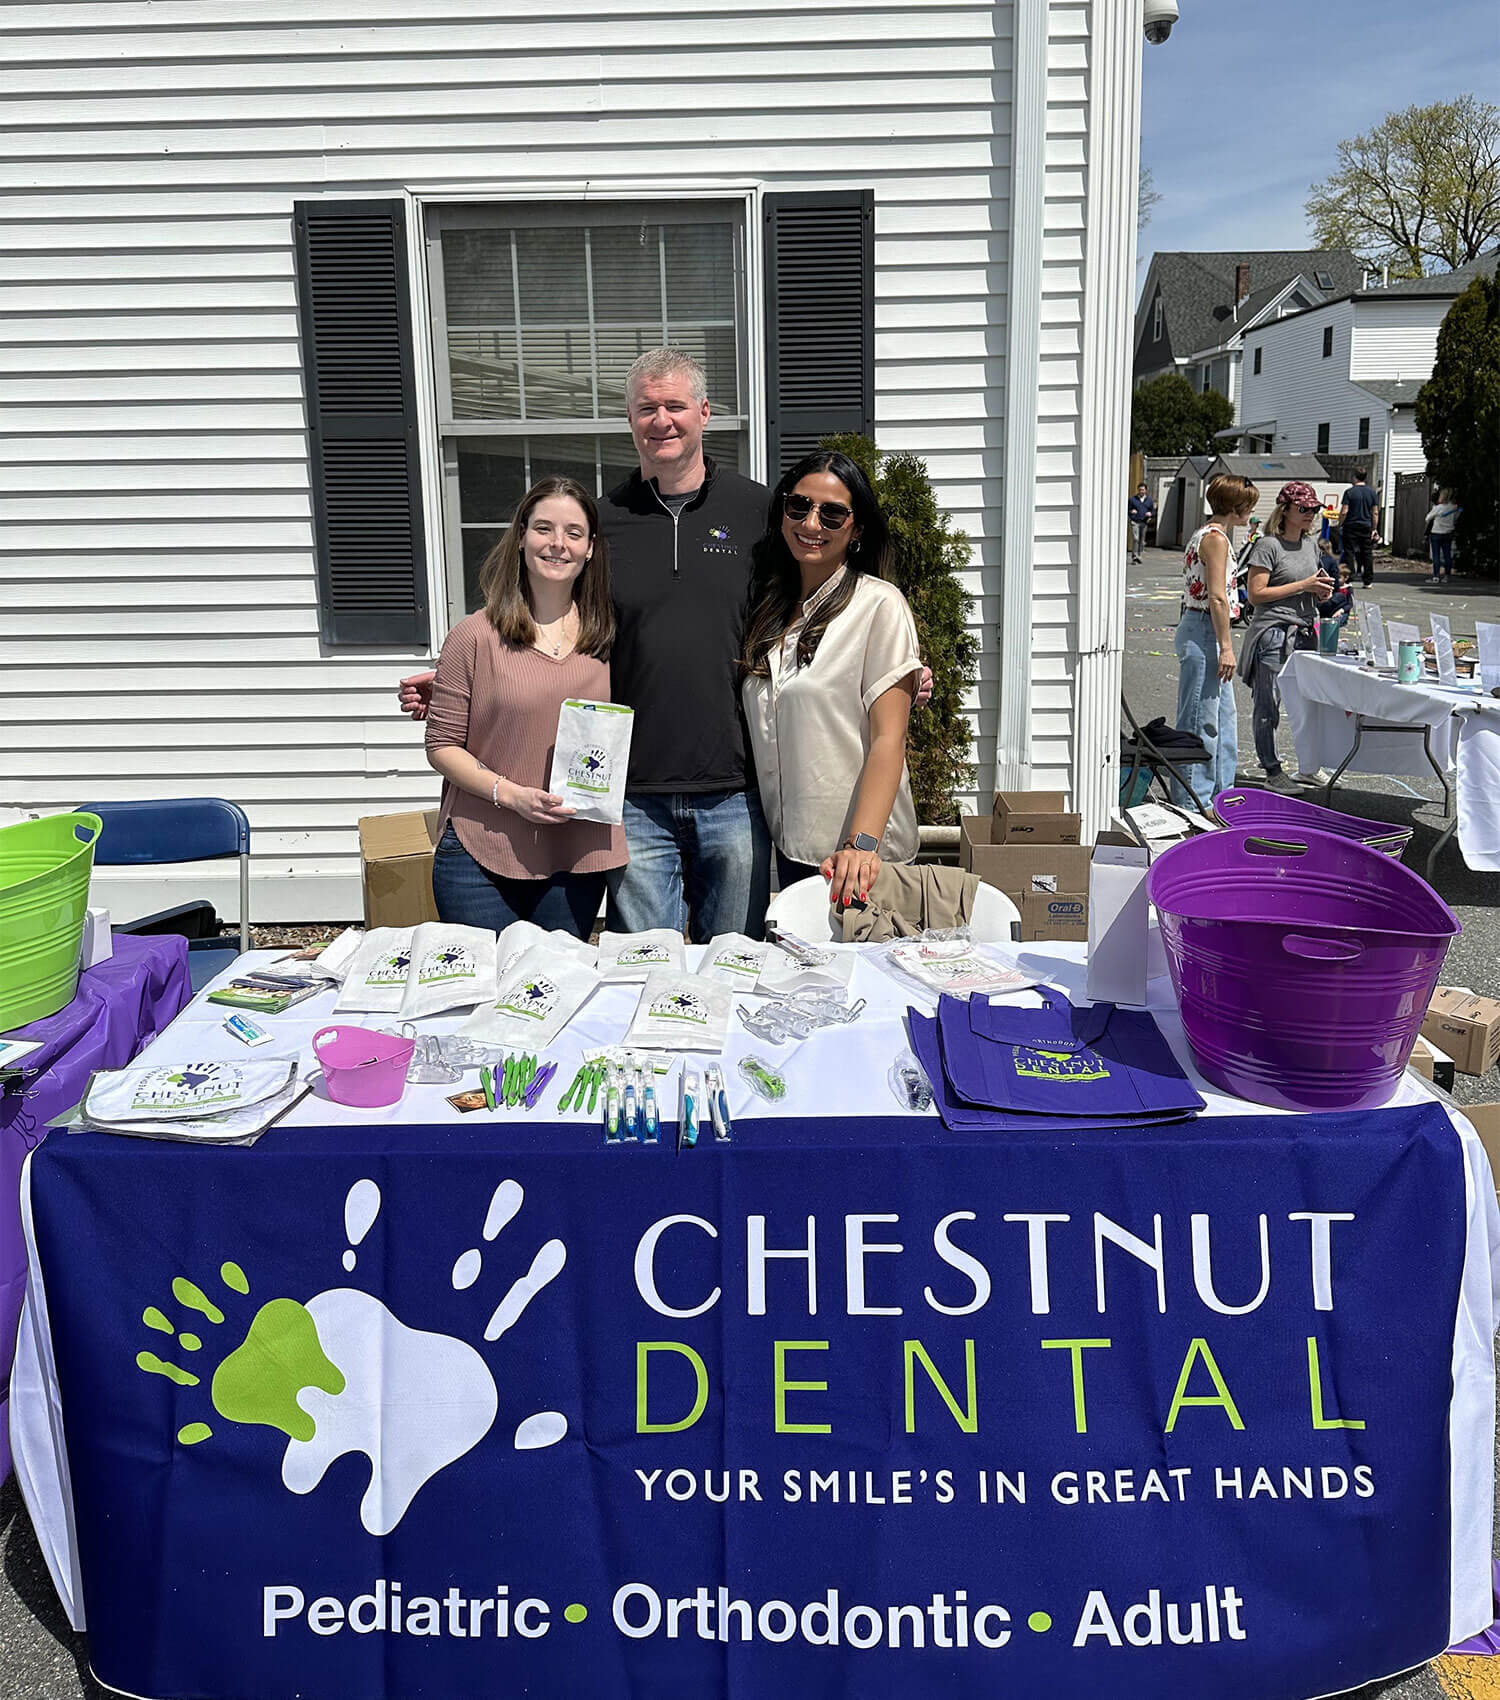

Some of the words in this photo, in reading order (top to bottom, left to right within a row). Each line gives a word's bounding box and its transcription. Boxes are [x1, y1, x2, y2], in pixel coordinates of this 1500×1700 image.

[568, 767, 612, 781] CHESTNUT
[1050, 903, 1081, 913] Oral-B
[418, 963, 477, 974] CHESTNUT
[1013, 1057, 1105, 1067] CHESTNUT
[1015, 1063, 1109, 1075] DENTAL
[135, 1081, 242, 1099] CHESTNUT
[634, 1210, 1356, 1318] CHESTNUT
[636, 1336, 1366, 1434] DENTAL
[634, 1468, 763, 1503] YOUR
[783, 1469, 955, 1505] SMILE’S
[979, 1470, 1026, 1504] IN
[1050, 1467, 1192, 1505] GREAT
[1214, 1465, 1375, 1499] HANDS
[263, 1579, 551, 1639] Pediatric
[612, 1582, 1012, 1649] Orthodontic
[1072, 1584, 1247, 1647] Adult
